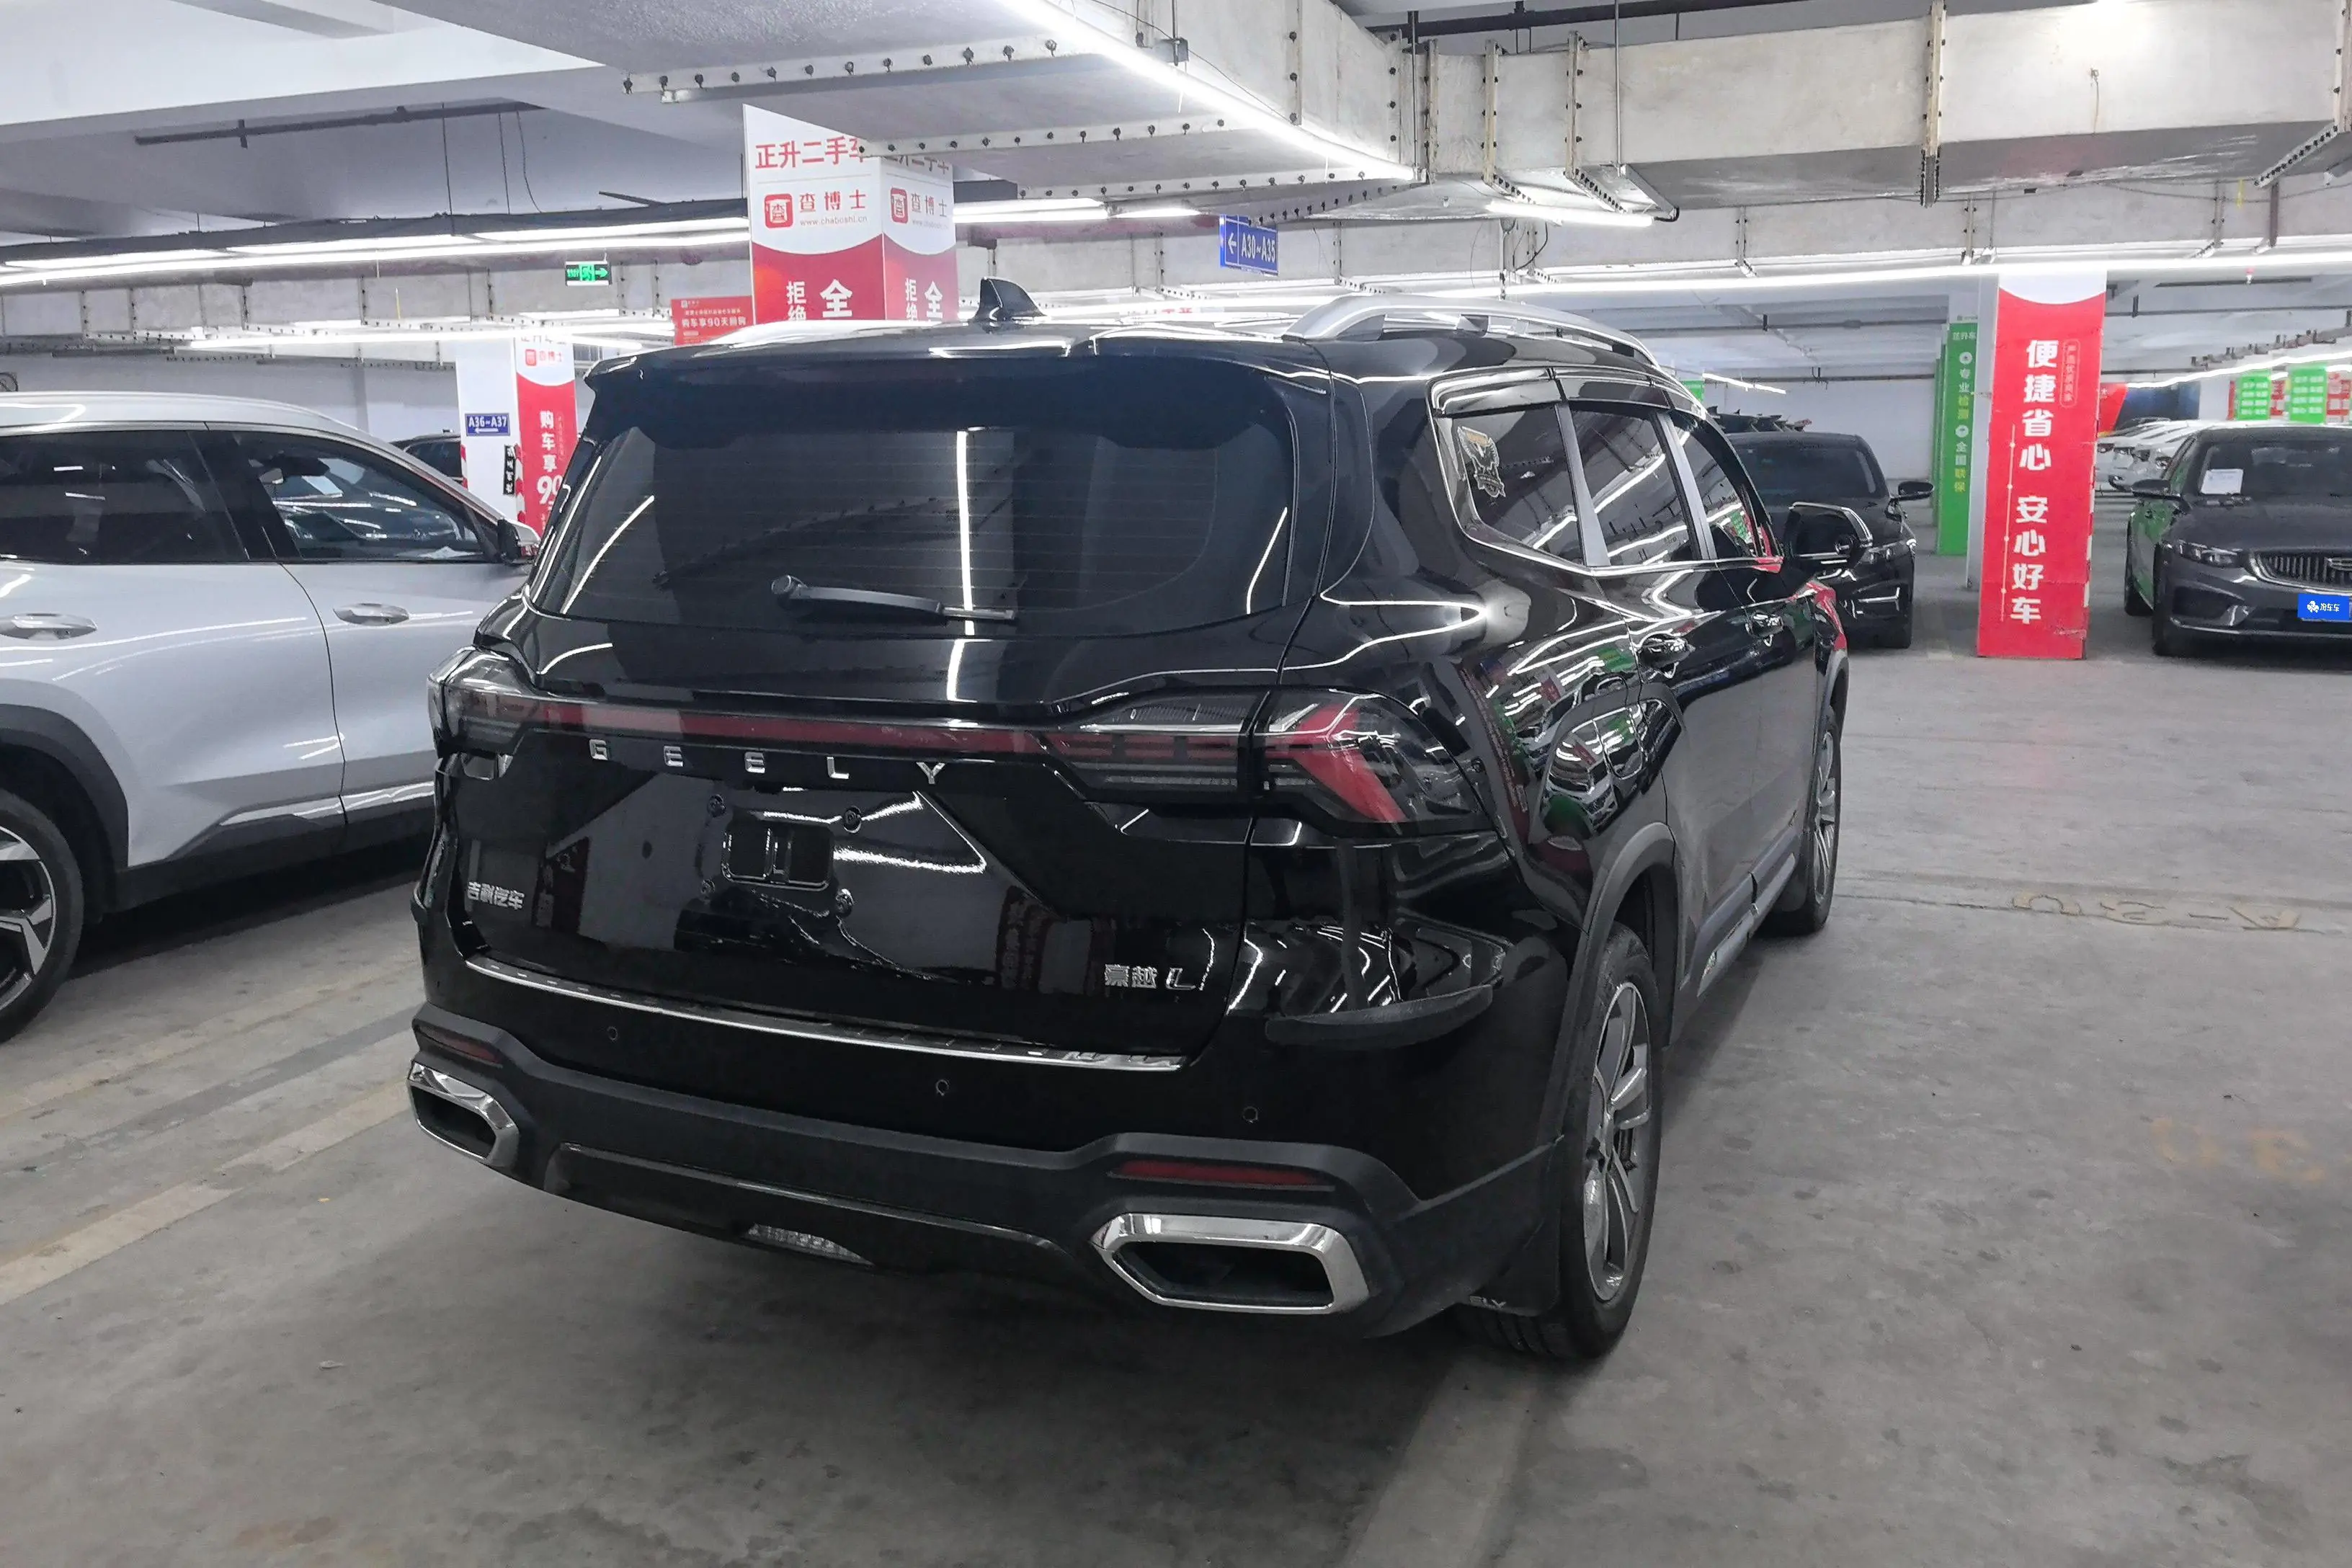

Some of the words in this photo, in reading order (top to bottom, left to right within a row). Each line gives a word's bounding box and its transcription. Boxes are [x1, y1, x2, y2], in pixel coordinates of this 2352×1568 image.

[800, 189, 866, 213] 查博士
[911, 192, 948, 217] 查博士
[786, 280, 806, 321] 拒绝
[819, 279, 853, 318] 全
[904, 278, 918, 321] 拒绝
[2018, 339, 2059, 471] 便捷省心
[2010, 496, 2049, 625] 安心好车
[589, 738, 945, 785] GEELY
